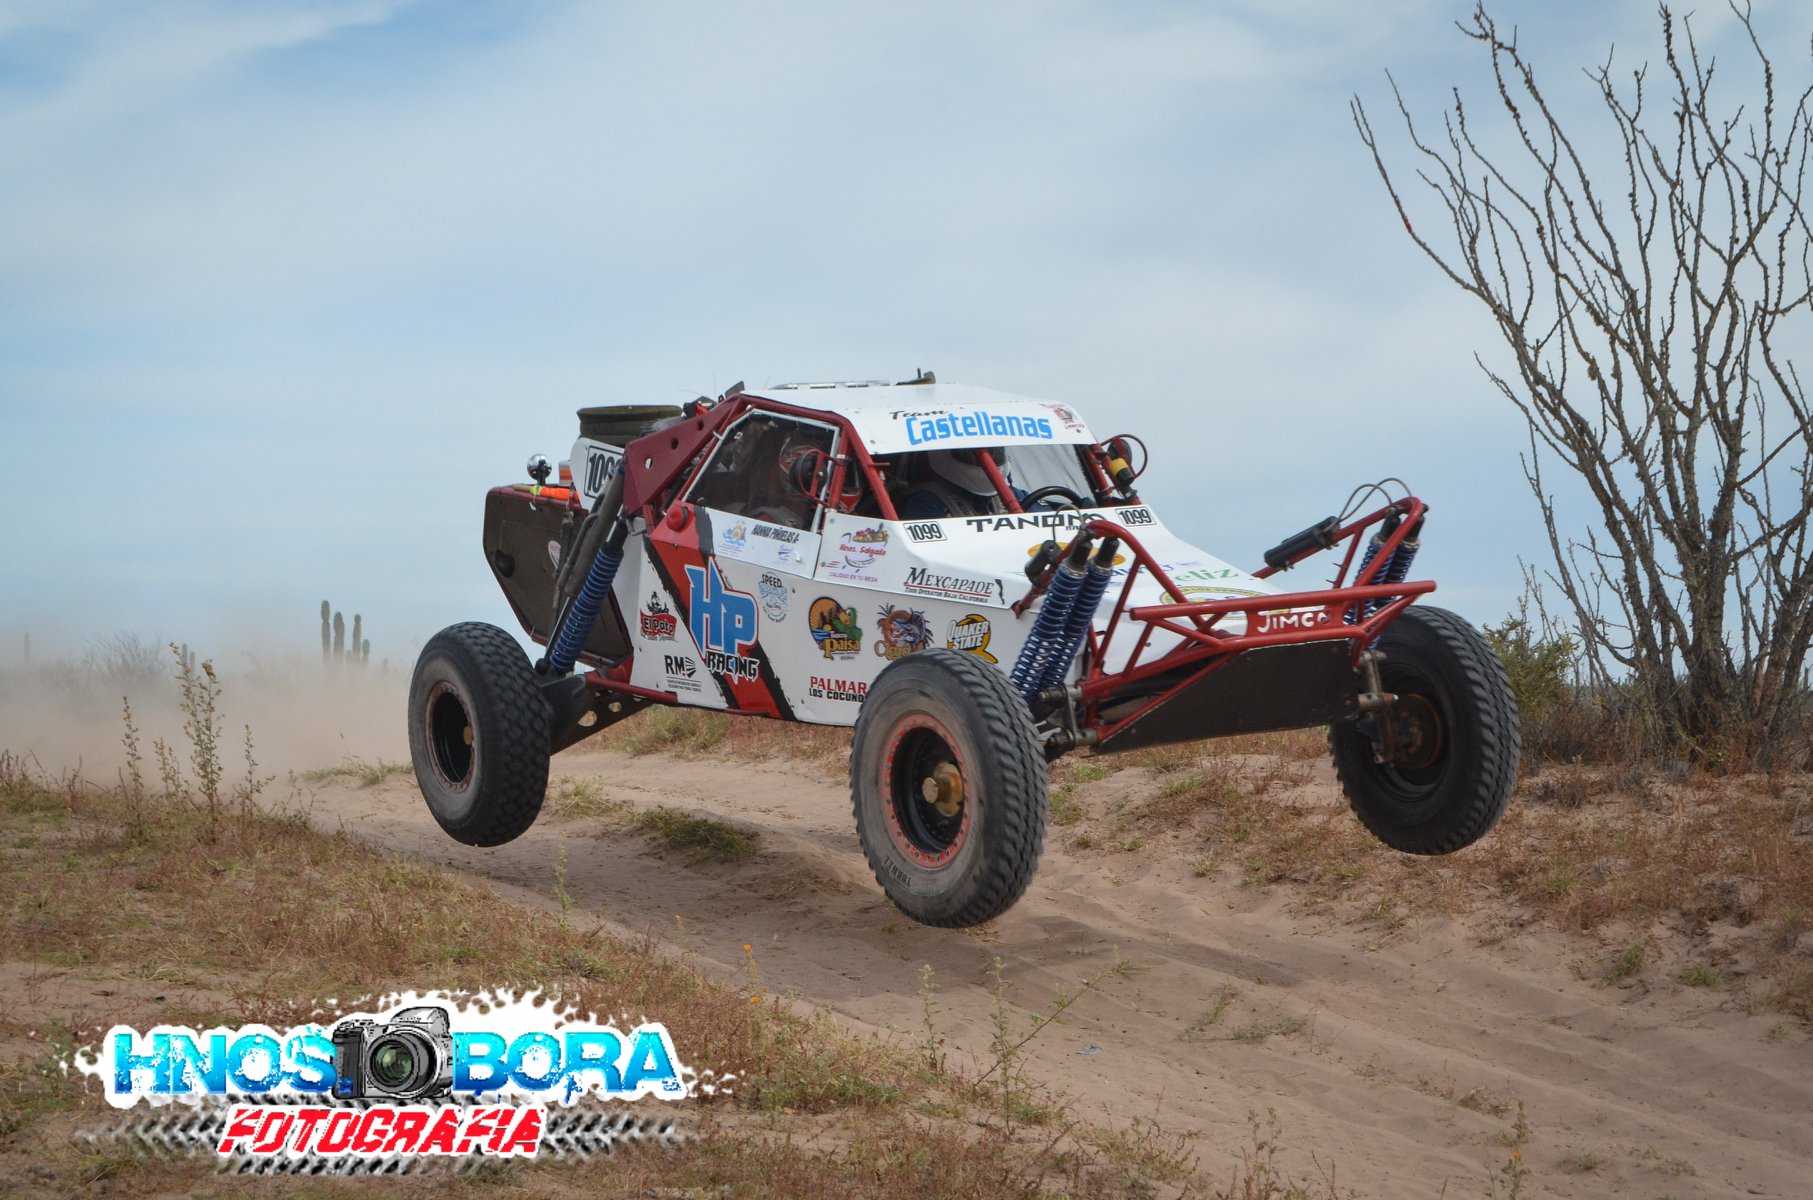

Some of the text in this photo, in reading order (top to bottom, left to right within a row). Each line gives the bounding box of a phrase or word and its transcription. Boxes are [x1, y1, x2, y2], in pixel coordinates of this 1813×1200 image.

[889, 409, 948, 420] Team
[905, 411, 1053, 446] Castellanas
[1118, 508, 1152, 525] 1099
[906, 524, 942, 541] 1099
[761, 573, 782, 588] SPEED
[684, 557, 758, 660] HP
[643, 615, 674, 633] El Pato
[947, 620, 989, 643] QUAKER
[953, 635, 983, 650] STATE
[706, 651, 760, 684] RACING
[809, 688, 823, 699] LOS
